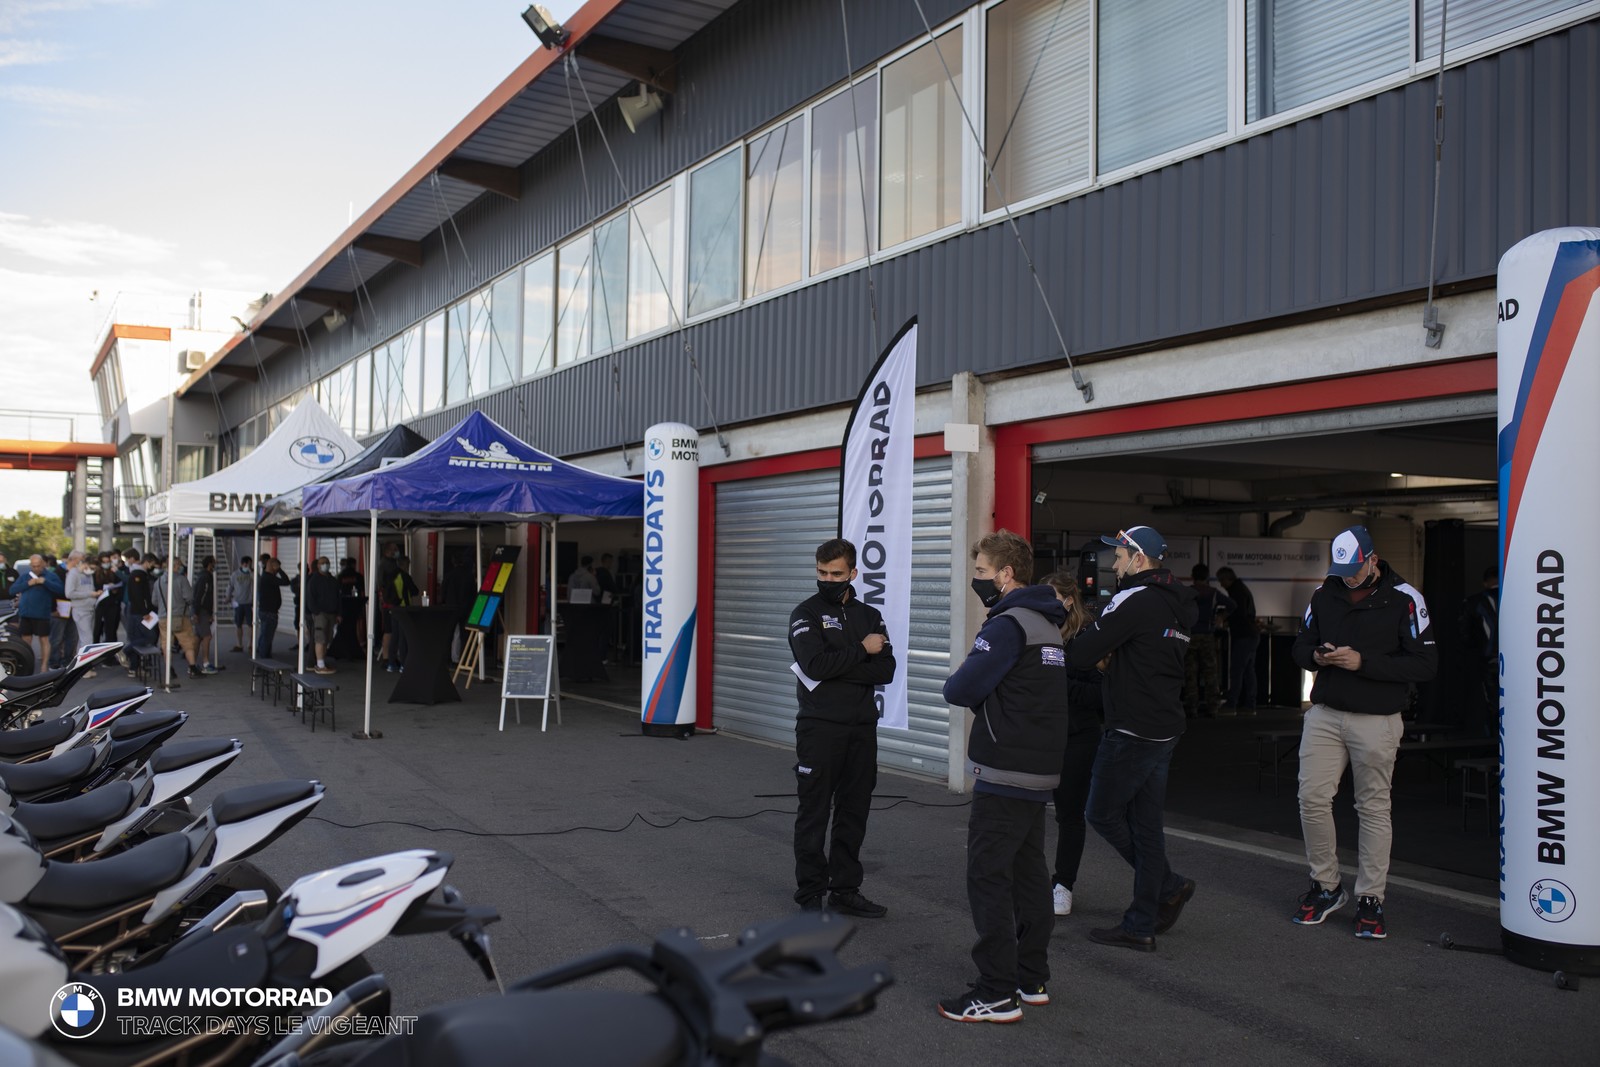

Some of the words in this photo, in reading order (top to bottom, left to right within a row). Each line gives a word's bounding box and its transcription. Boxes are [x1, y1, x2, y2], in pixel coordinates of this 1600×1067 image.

[448, 458, 552, 472] MICHELIN
[645, 469, 664, 659] TRACKDAYS
[1245, 552, 1281, 560] MOTORRAD
[1284, 552, 1303, 560] TRACK
[1536, 549, 1566, 761] MOTORRAD
[1537, 771, 1565, 866] BMW
[1531, 882, 1543, 914] BMW
